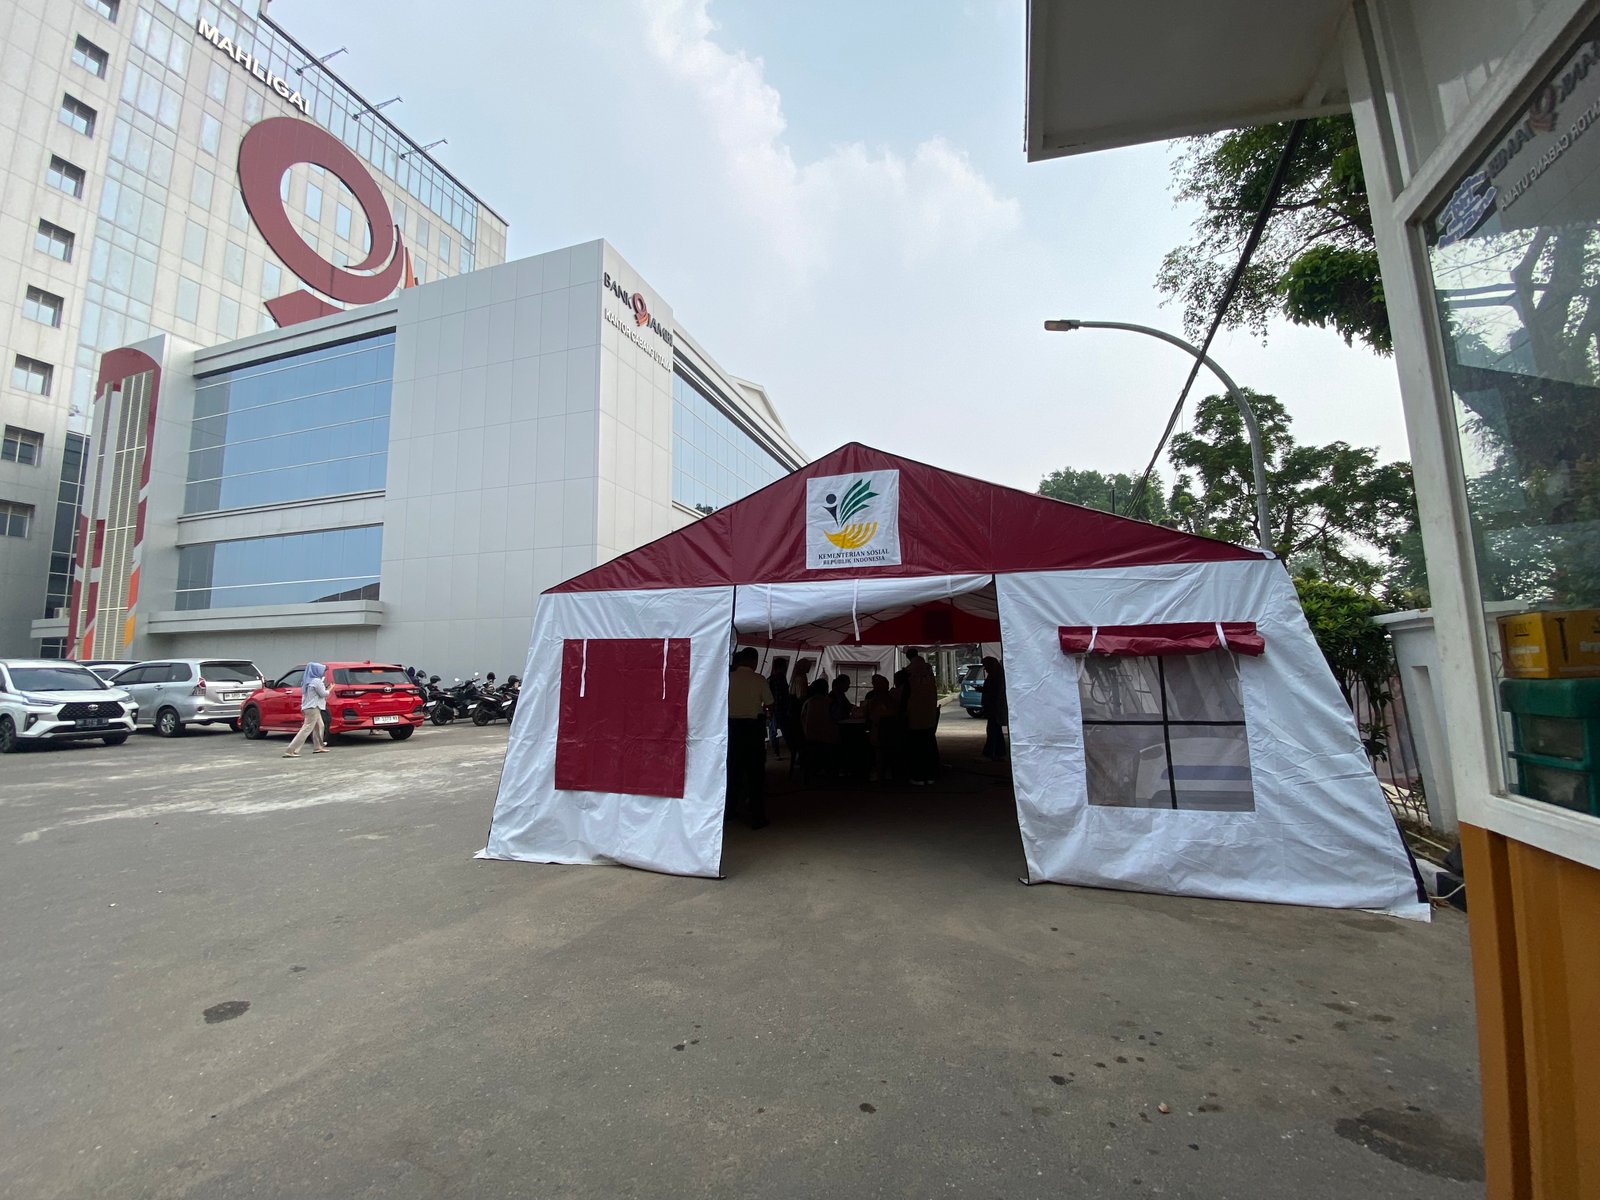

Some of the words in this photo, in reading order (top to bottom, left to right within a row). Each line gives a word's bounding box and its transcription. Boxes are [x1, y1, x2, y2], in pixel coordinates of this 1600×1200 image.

[198, 16, 310, 115] MAHLIGAI
[604, 272, 632, 309] BANK
[818, 551, 865, 559] KEMENTERIAN
